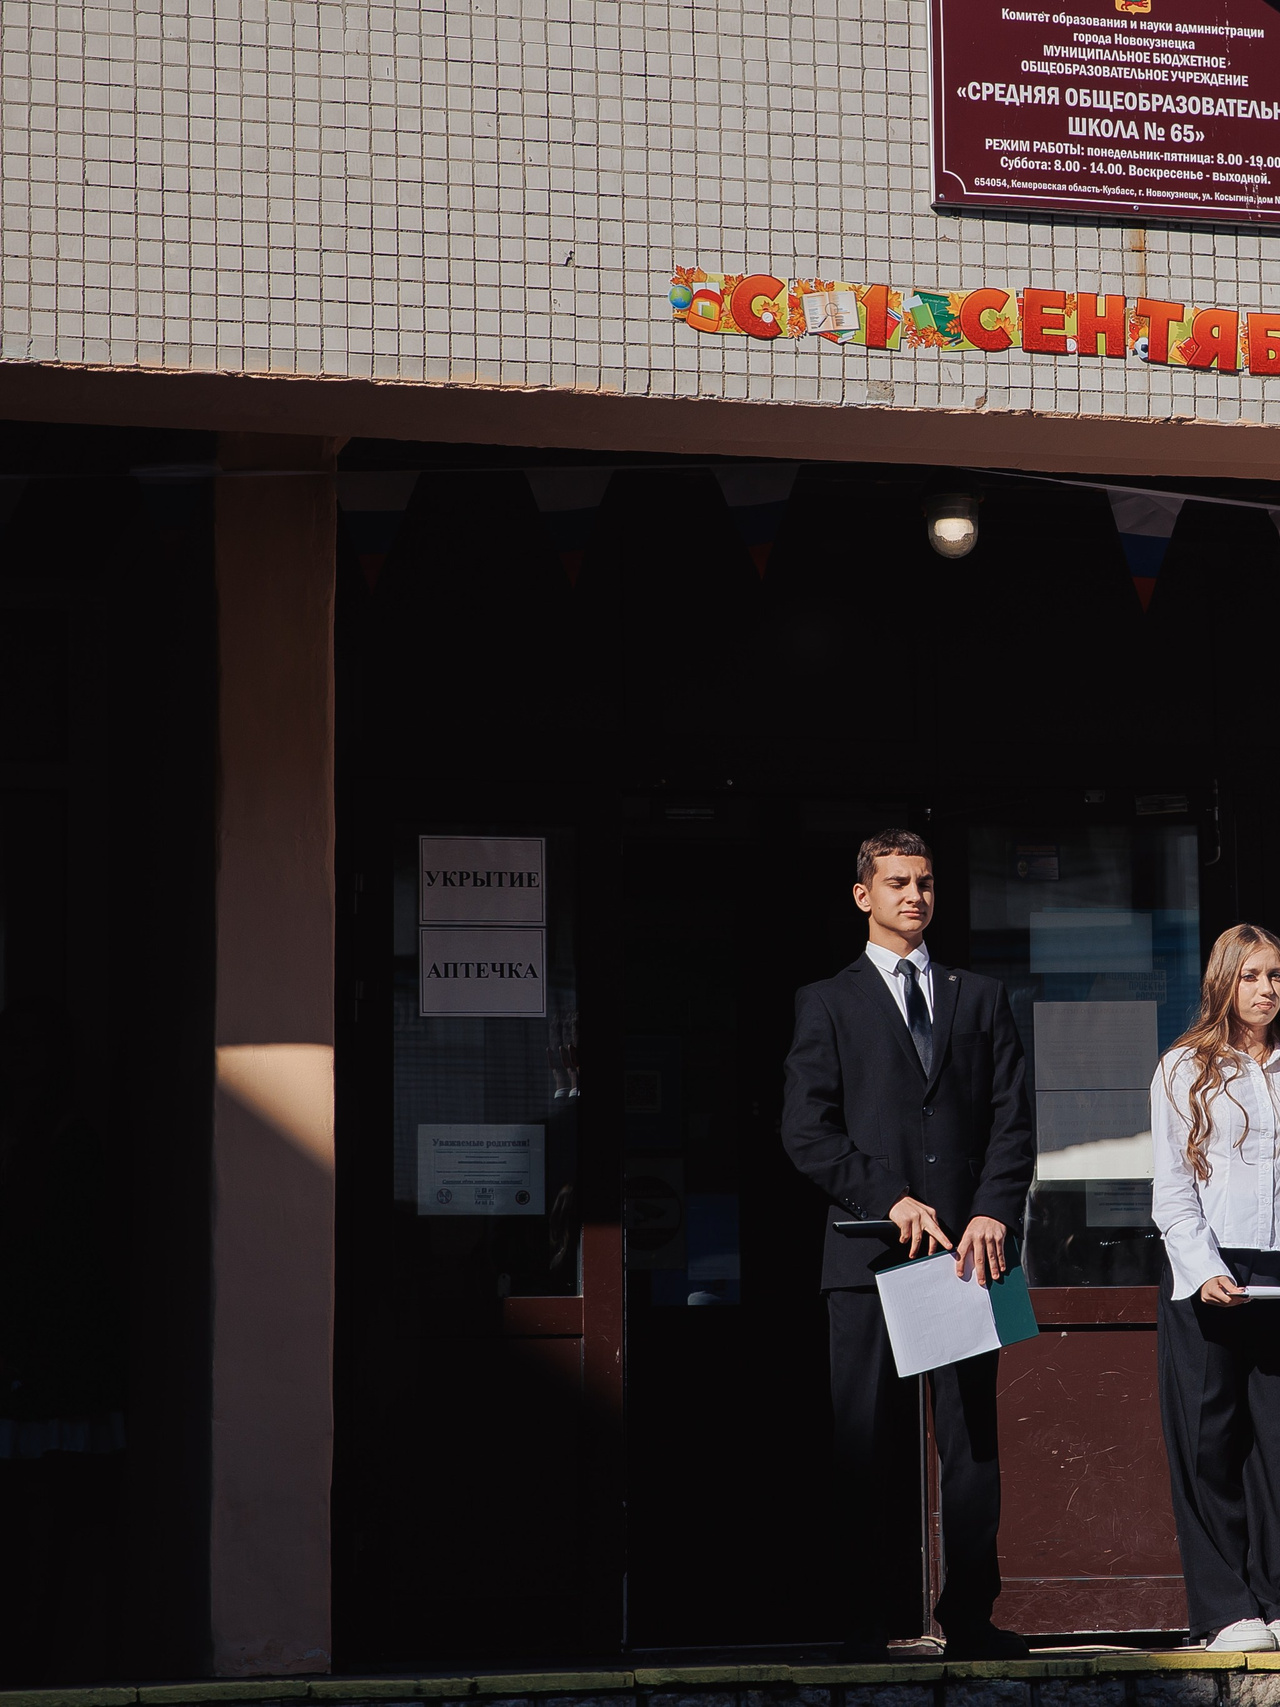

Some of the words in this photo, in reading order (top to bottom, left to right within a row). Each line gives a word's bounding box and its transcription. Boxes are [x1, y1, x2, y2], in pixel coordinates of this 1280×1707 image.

[1002, 8, 1050, 23] Комитет
[1052, 12, 1127, 29] образования
[1130, 20, 1137, 29] и
[1140, 21, 1172, 33] науки
[1175, 22, 1264, 39] администрации
[1073, 32, 1112, 45] города
[1114, 33, 1195, 50] Новокузнецка
[1043, 44, 1151, 64] МУНИЦИПАЛЬНОЕ
[1153, 52, 1226, 69] БЮДЖЕТНОЕ
[1021, 60, 1169, 82] ОБЩЕОБРАЗОВАТЕЛЬНОЕ
[1170, 70, 1249, 87] УЧРЕЖДЕНИЕ
[957, 81, 1059, 106] «СРЕДНЯЯ
[1068, 116, 1139, 139] ШКОЛА
[1144, 121, 1165, 141] №
[1170, 123, 1205, 143] 65»
[985, 138, 1030, 152] РЕЖИМ
[1033, 141, 1084, 156] РАБОТЫ:
[1087, 147, 1214, 165] понедельник-пятница:
[1217, 153, 1243, 166] 8.00
[1000, 156, 1051, 171] Суббота:
[1054, 159, 1080, 172] 8.00
[1090, 162, 1126, 176] 14.00.
[1129, 164, 1203, 180] Воскресенье
[1212, 172, 1271, 188] выходной.
[1012, 180, 1067, 191] Кемеровская
[1068, 182, 1137, 197] область-Кузбасс,
[1146, 188, 1201, 201] Новокузнецк,
[1202, 193, 1213, 202] ул.
[1257, 196, 1273, 205] дом
[730, 274, 786, 339] С
[860, 284, 890, 350] 1
[425, 870, 540, 888] УКРЫТИЕ
[426, 962, 539, 979] АПТЕЧКА
[1129, 981, 1165, 991] ПРОЕКТЫ
[432, 1139, 484, 1147] Уважаемые
[486, 1139, 530, 1148] родители!
